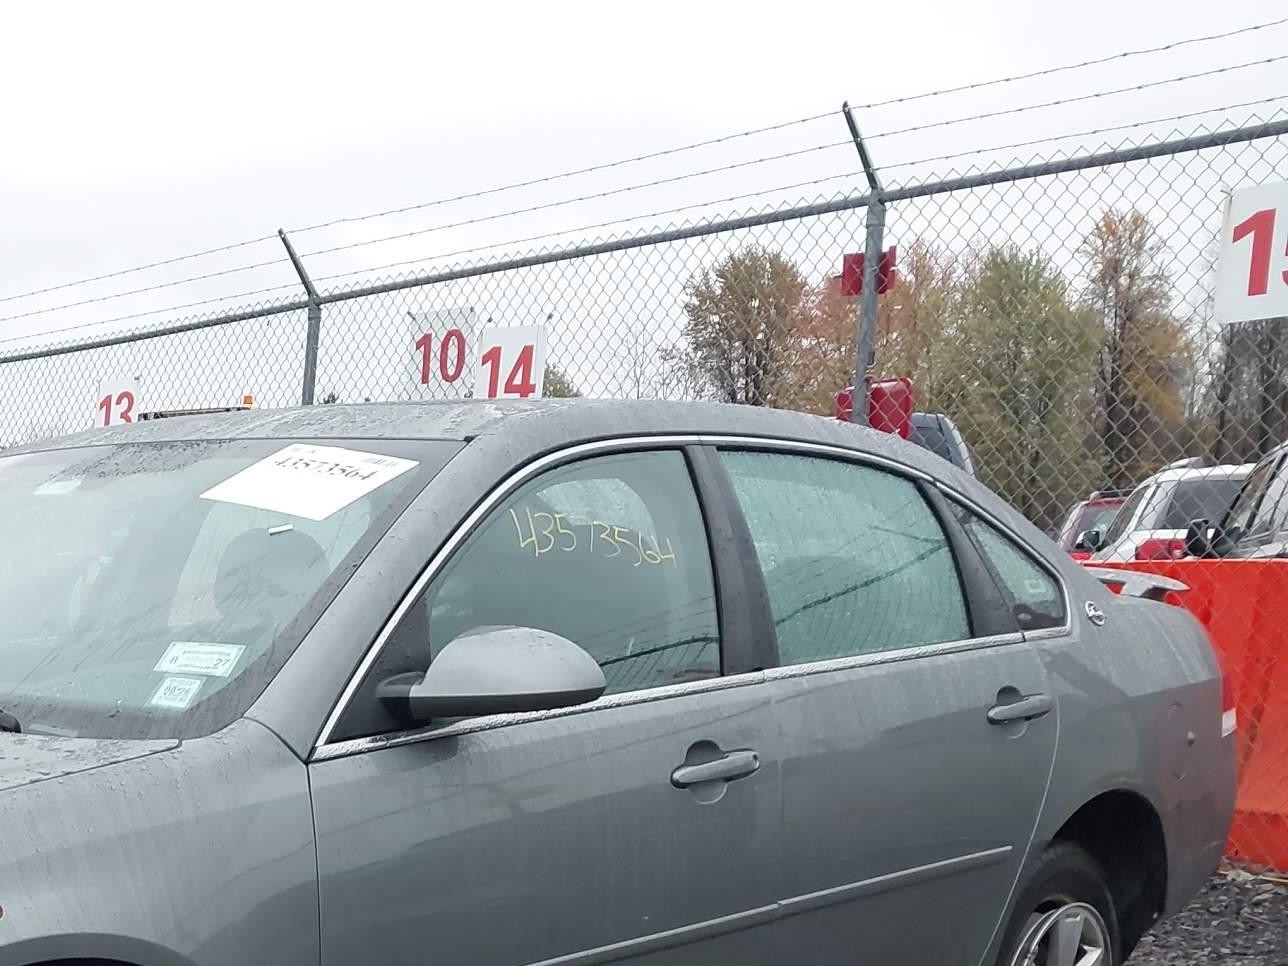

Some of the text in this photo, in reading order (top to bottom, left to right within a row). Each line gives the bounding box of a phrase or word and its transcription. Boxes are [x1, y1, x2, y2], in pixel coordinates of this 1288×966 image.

[1232, 208, 1288, 296] 1
[415, 328, 466, 385] 10
[481, 344, 537, 398] 14
[99, 391, 134, 426] 13
[510, 506, 678, 569] 43573564
